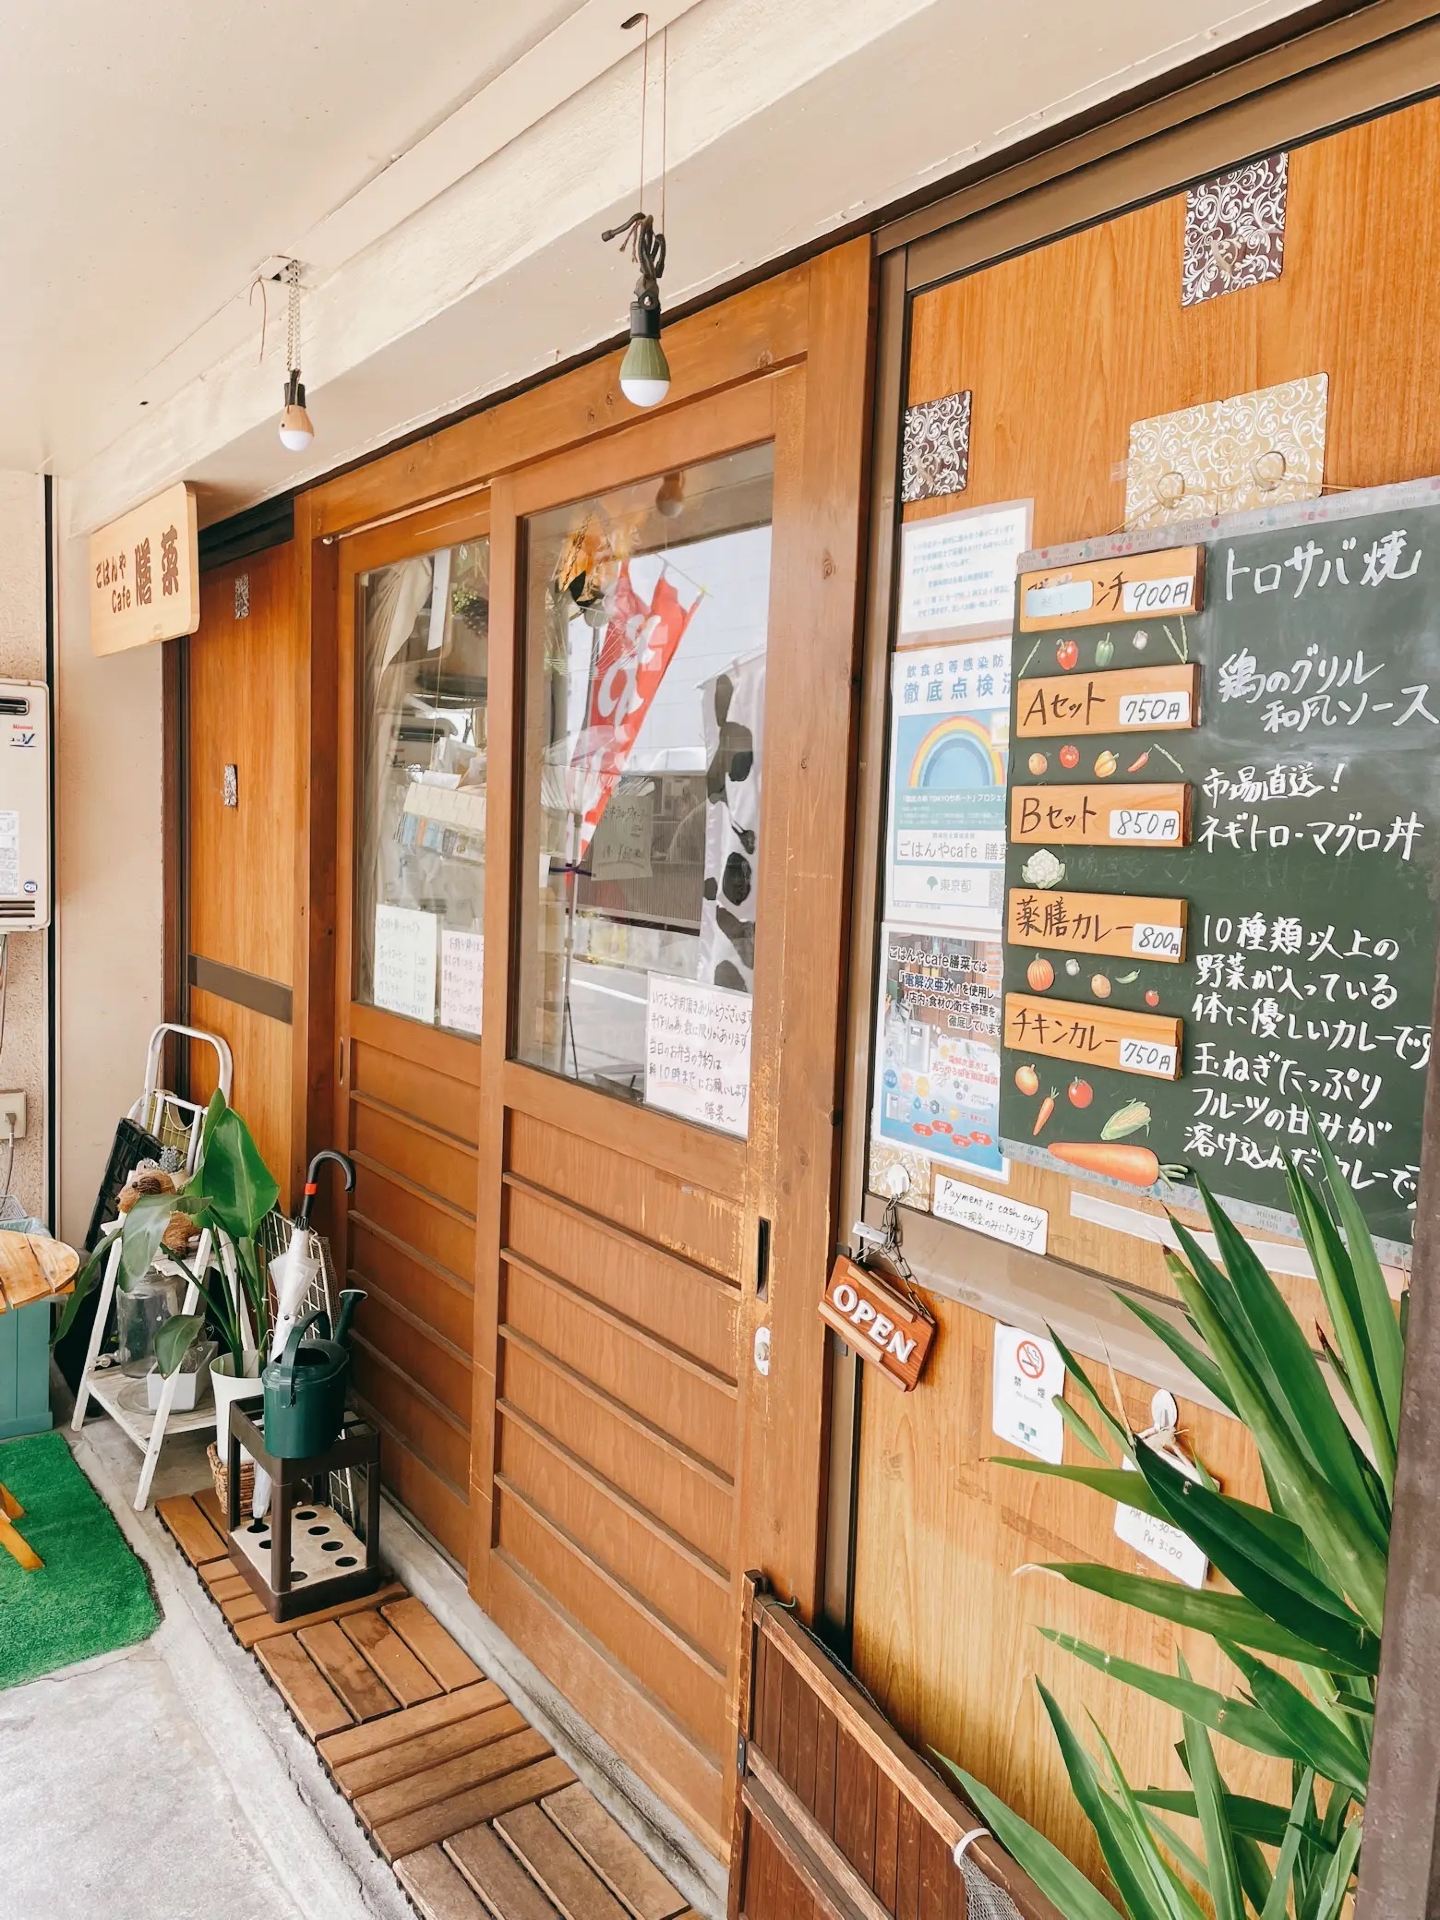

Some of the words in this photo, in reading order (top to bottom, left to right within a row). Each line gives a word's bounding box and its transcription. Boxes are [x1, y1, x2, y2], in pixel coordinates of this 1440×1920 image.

[96, 550, 127, 589] ごはんや
[1226, 528, 1423, 601] トロサバ焼
[112, 585, 131, 614] Cafe
[1133, 581, 1189, 612] 900円
[906, 653, 1011, 679] 飲食店等感染防
[1023, 681, 1106, 727] Aセット
[1125, 699, 1181, 723] 750円
[1020, 795, 1098, 835] Bセット
[1116, 810, 1176, 836] 850円
[1015, 894, 1134, 942] 薬膳カレー
[1138, 926, 1180, 955] 800円
[1194, 952, 1398, 1010] 野菜が入っている
[1012, 1007, 1119, 1052] チキンカレー
[1123, 1042, 1171, 1072] 750円
[1192, 1042, 1382, 1110] 玉ねぎたっぷり
[1192, 1087, 1393, 1147] フルーツの甘みが
[1183, 1121, 1420, 1205] 溶け込んだレーで
[943, 1180, 983, 1205] Payment
[985, 1200, 993, 1211] is
[1023, 1214, 1044, 1231] only
[832, 1284, 918, 1364] OPEN
